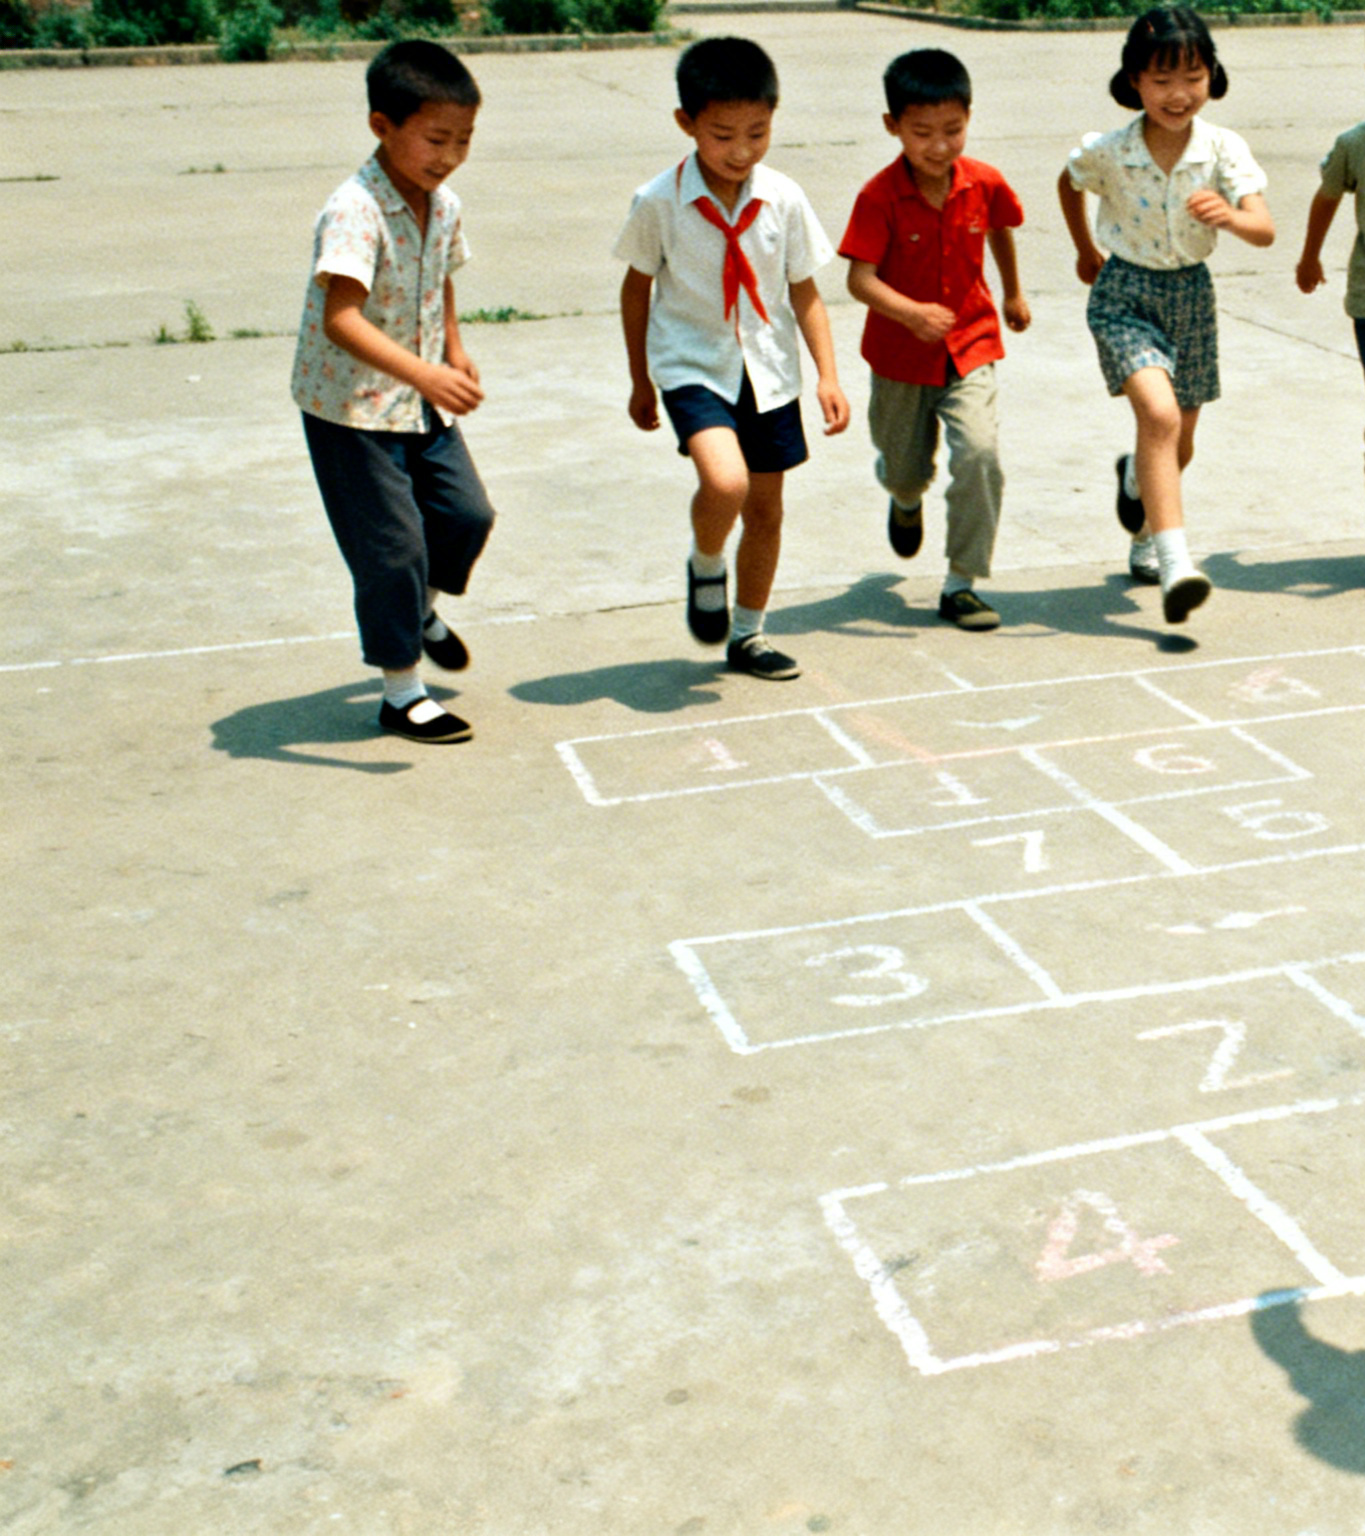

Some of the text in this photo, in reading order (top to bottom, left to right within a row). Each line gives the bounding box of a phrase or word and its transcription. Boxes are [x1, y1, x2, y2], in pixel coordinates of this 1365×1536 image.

[702, 737, 749, 772] 1
[1133, 743, 1216, 774] 6
[1220, 798, 1330, 841] 5
[804, 944, 929, 1007] 3
[1034, 1188, 1181, 1284] 4
